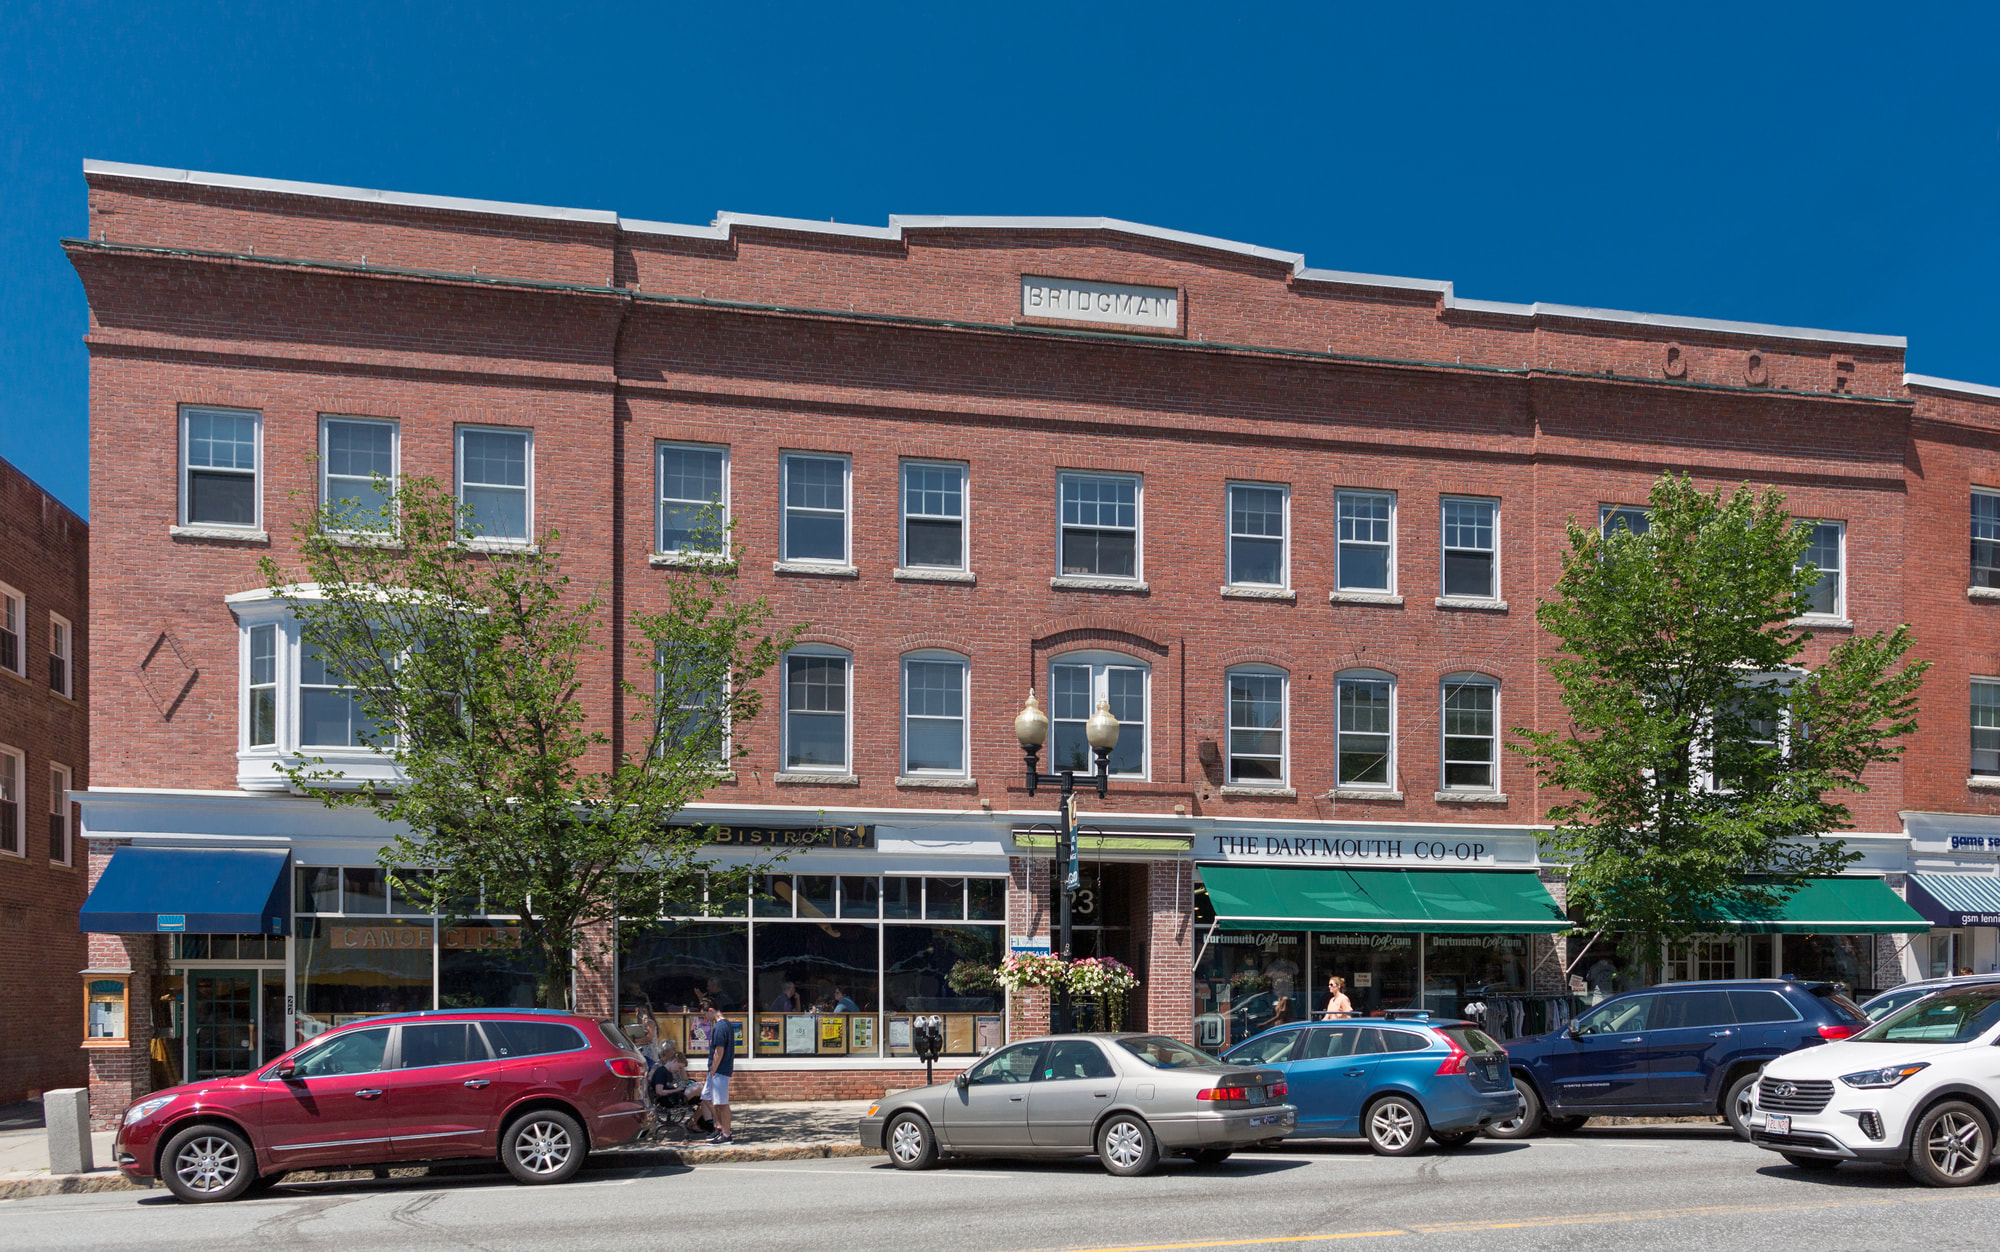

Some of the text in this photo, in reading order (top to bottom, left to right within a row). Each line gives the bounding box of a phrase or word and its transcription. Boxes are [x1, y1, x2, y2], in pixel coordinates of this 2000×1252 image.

[1030, 286, 1170, 319] BRIDGMAN
[1213, 835, 1485, 861] THE DARTMOUTH CO-OP
[1951, 836, 1984, 848] game
[1961, 914, 1979, 925] gsm
[344, 928, 431, 948] CANOE
